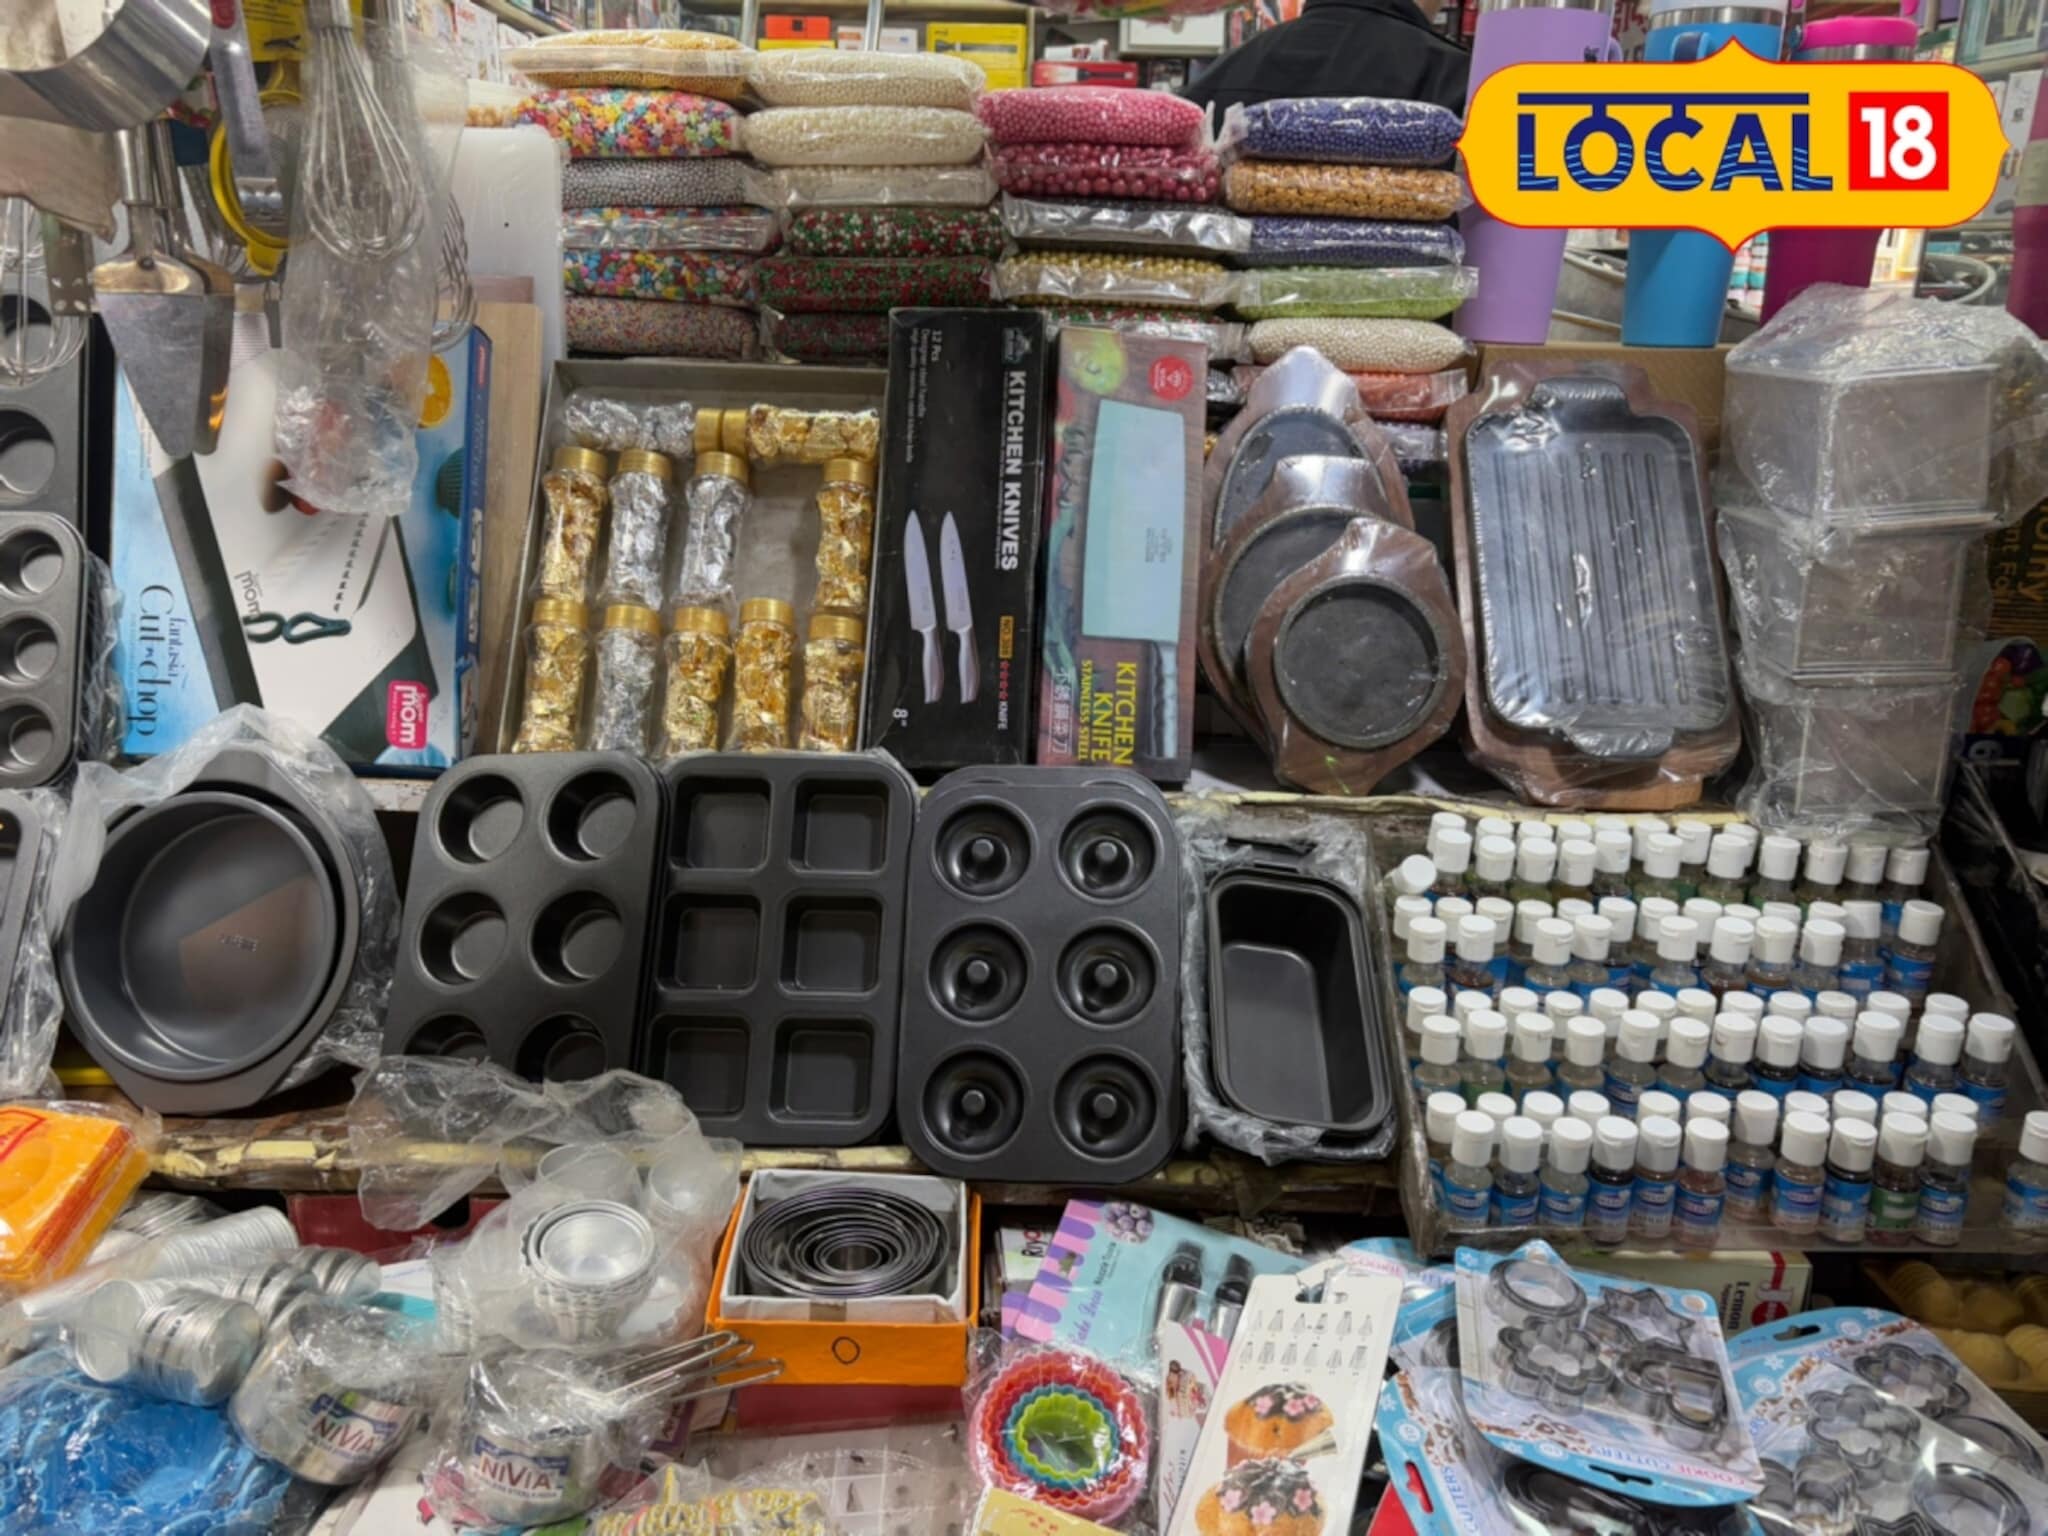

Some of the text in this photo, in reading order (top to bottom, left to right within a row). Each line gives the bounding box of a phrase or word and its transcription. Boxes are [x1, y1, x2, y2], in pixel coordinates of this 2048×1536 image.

[1005, 371, 1027, 476] KITCHEN
[1000, 482, 1022, 571] KNIVES
[139, 585, 175, 641] Cut
[128, 661, 172, 736] chop
[395, 685, 418, 744] mom
[997, 701, 1009, 731] KNIFE
[1078, 660, 1093, 761] STAINLESS STEEL
[1091, 693, 1114, 763] KNIFE
[1113, 662, 1137, 765] KITCHEN
[1727, 1281, 1751, 1330] Lemon
[310, 1413, 378, 1456] NIVIA
[480, 1450, 553, 1494] NIVIA
